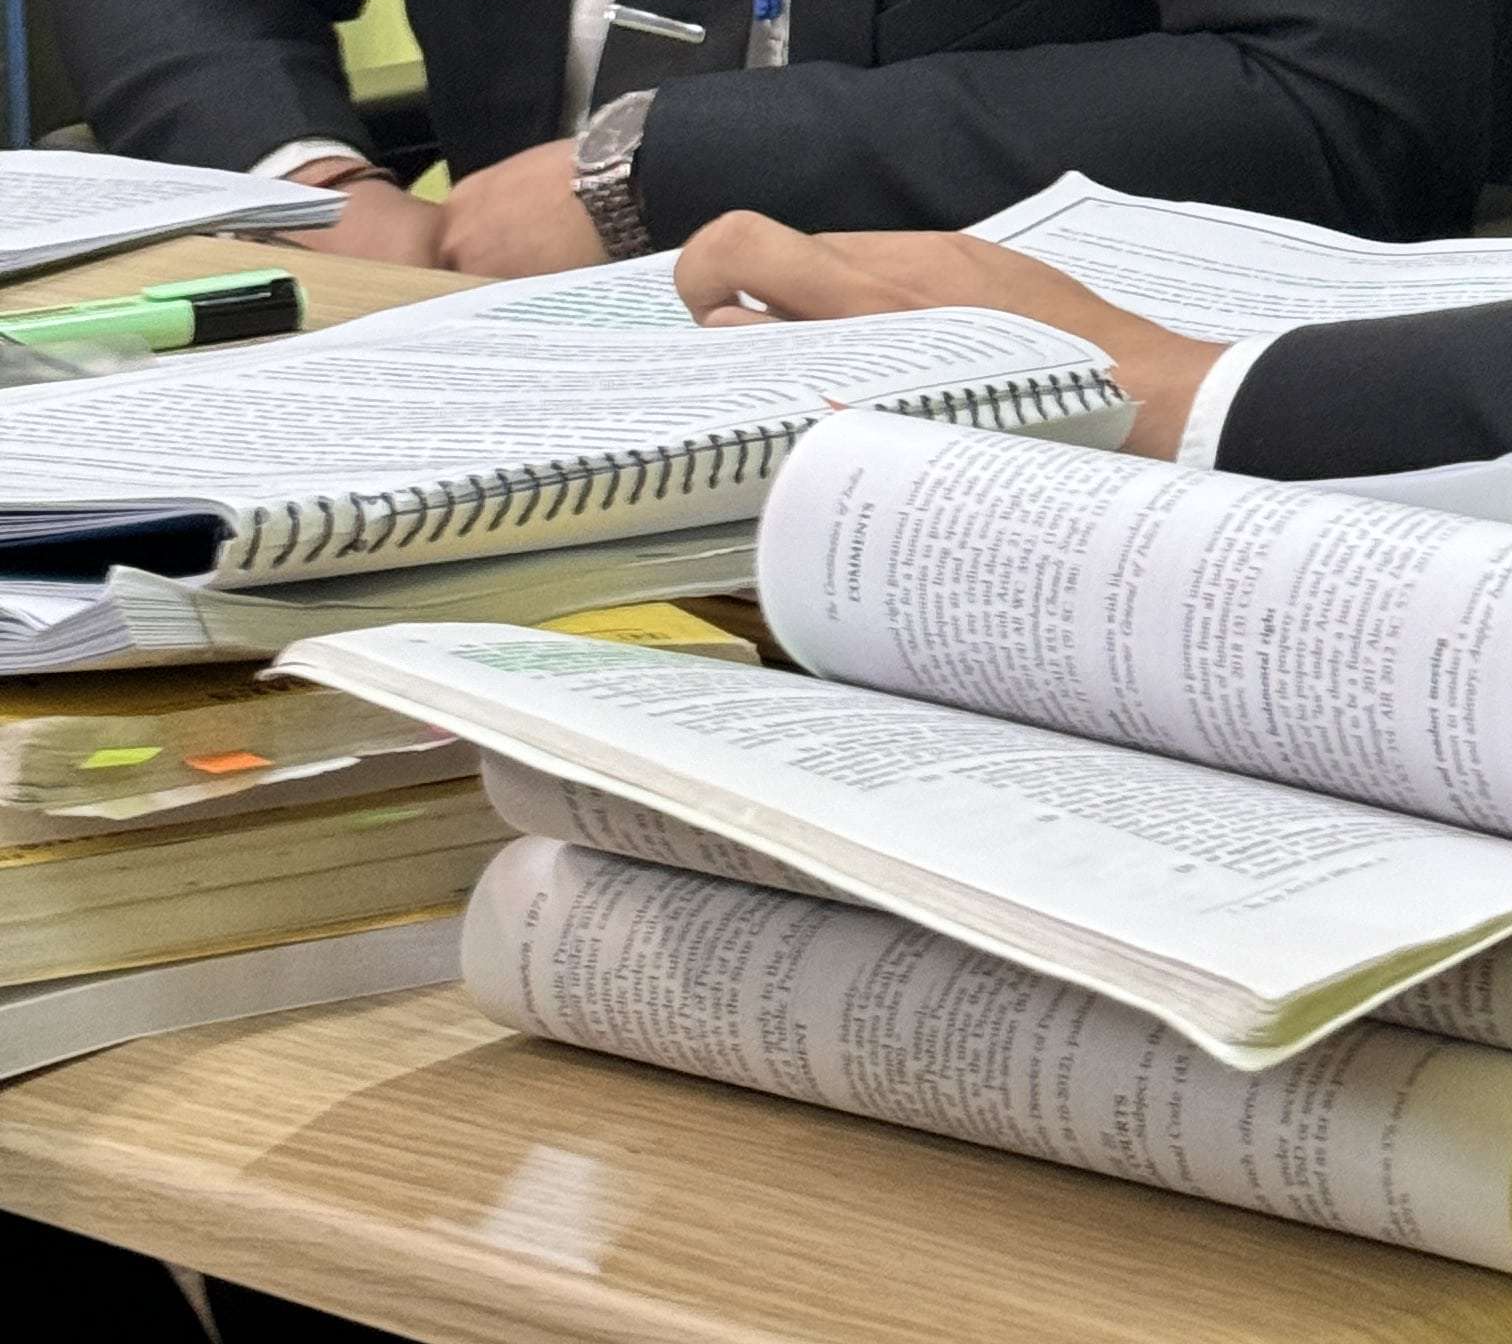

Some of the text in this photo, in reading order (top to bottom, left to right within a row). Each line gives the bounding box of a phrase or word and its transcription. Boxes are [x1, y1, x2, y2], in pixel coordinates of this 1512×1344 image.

[849, 502, 874, 603] COMMENTS
[1258, 607, 1275, 646] right
[1258, 652, 1280, 736] fundamental
[522, 892, 548, 929] 1973
